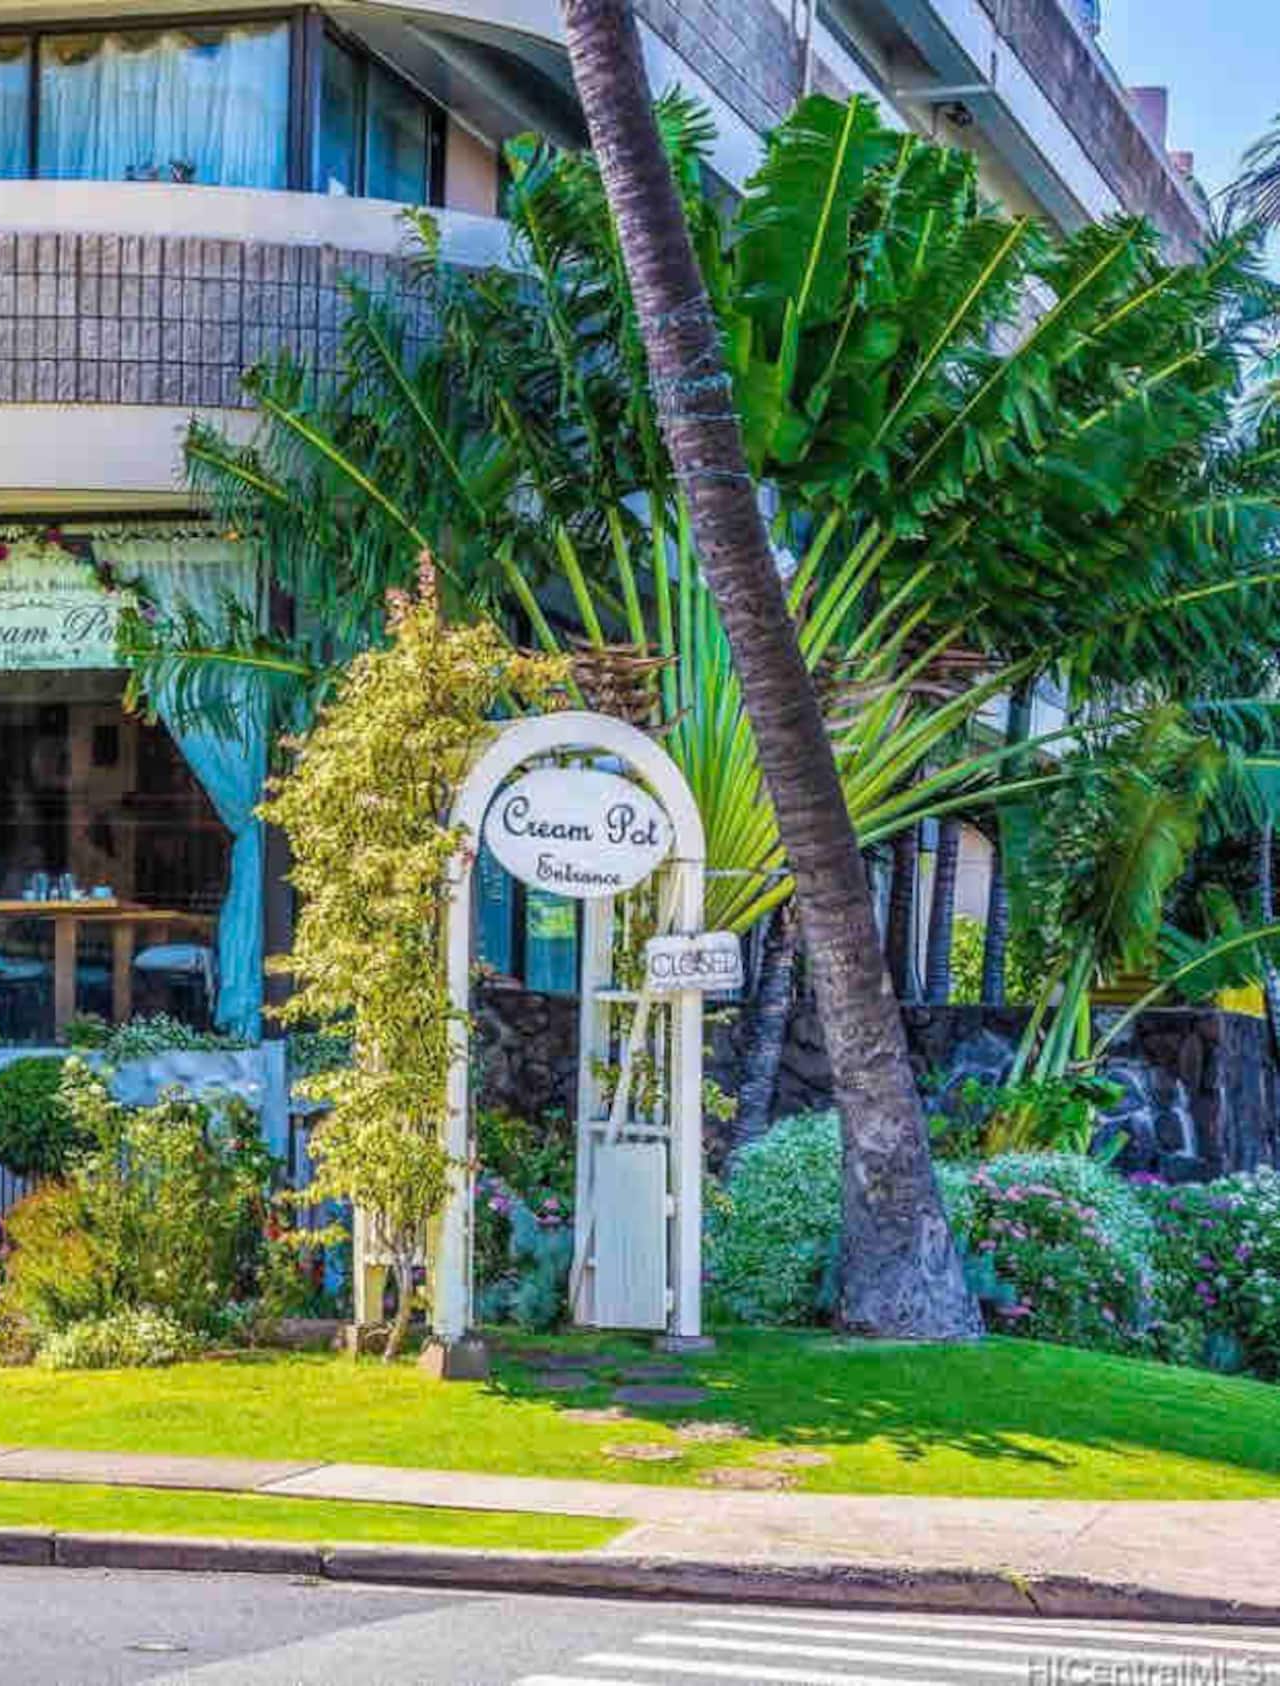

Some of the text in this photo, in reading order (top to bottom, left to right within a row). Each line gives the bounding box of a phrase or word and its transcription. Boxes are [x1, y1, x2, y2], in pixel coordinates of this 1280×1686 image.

[61, 603, 116, 641] Po
[503, 796, 659, 845] Cream Pot
[535, 853, 622, 886] Entrance
